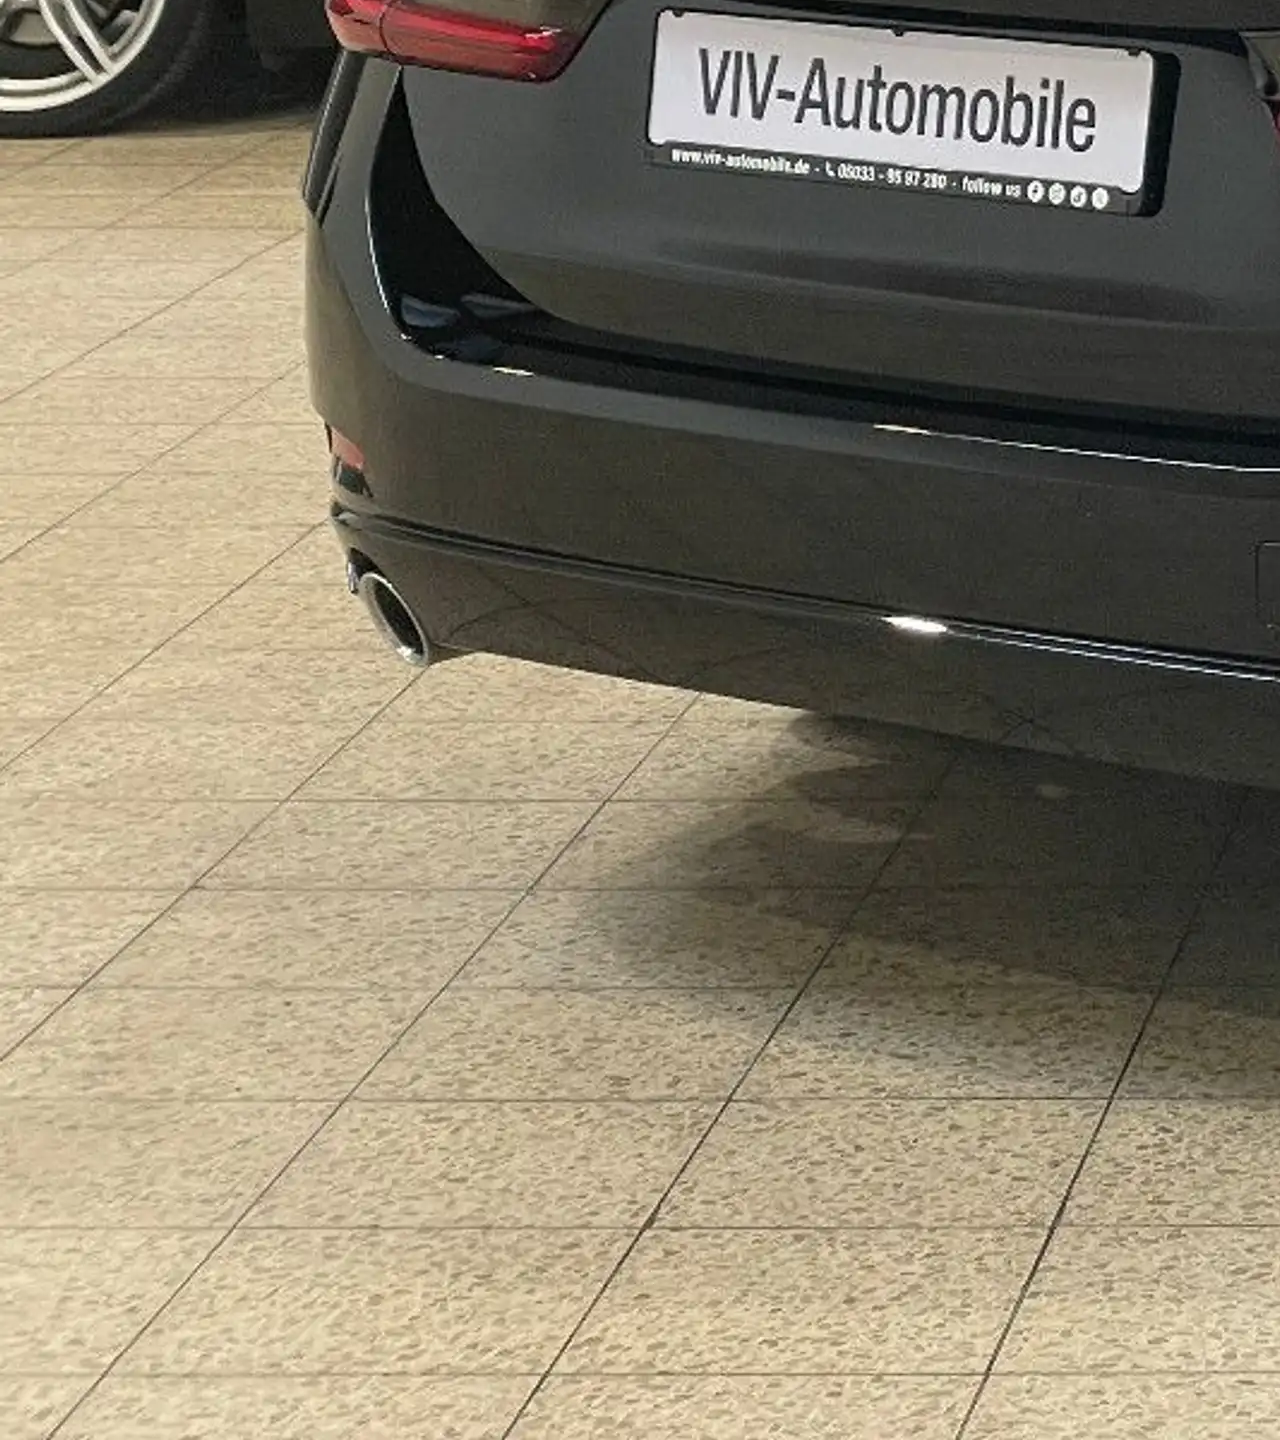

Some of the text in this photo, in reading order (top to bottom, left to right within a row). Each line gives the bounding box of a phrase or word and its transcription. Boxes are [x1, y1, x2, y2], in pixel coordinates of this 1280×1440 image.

[699, 47, 1097, 152] VIV-Automobile
[671, 148, 810, 175] www.viv-automobile.de
[962, 175, 1002, 195] follow
[1005, 184, 1021, 197] us
